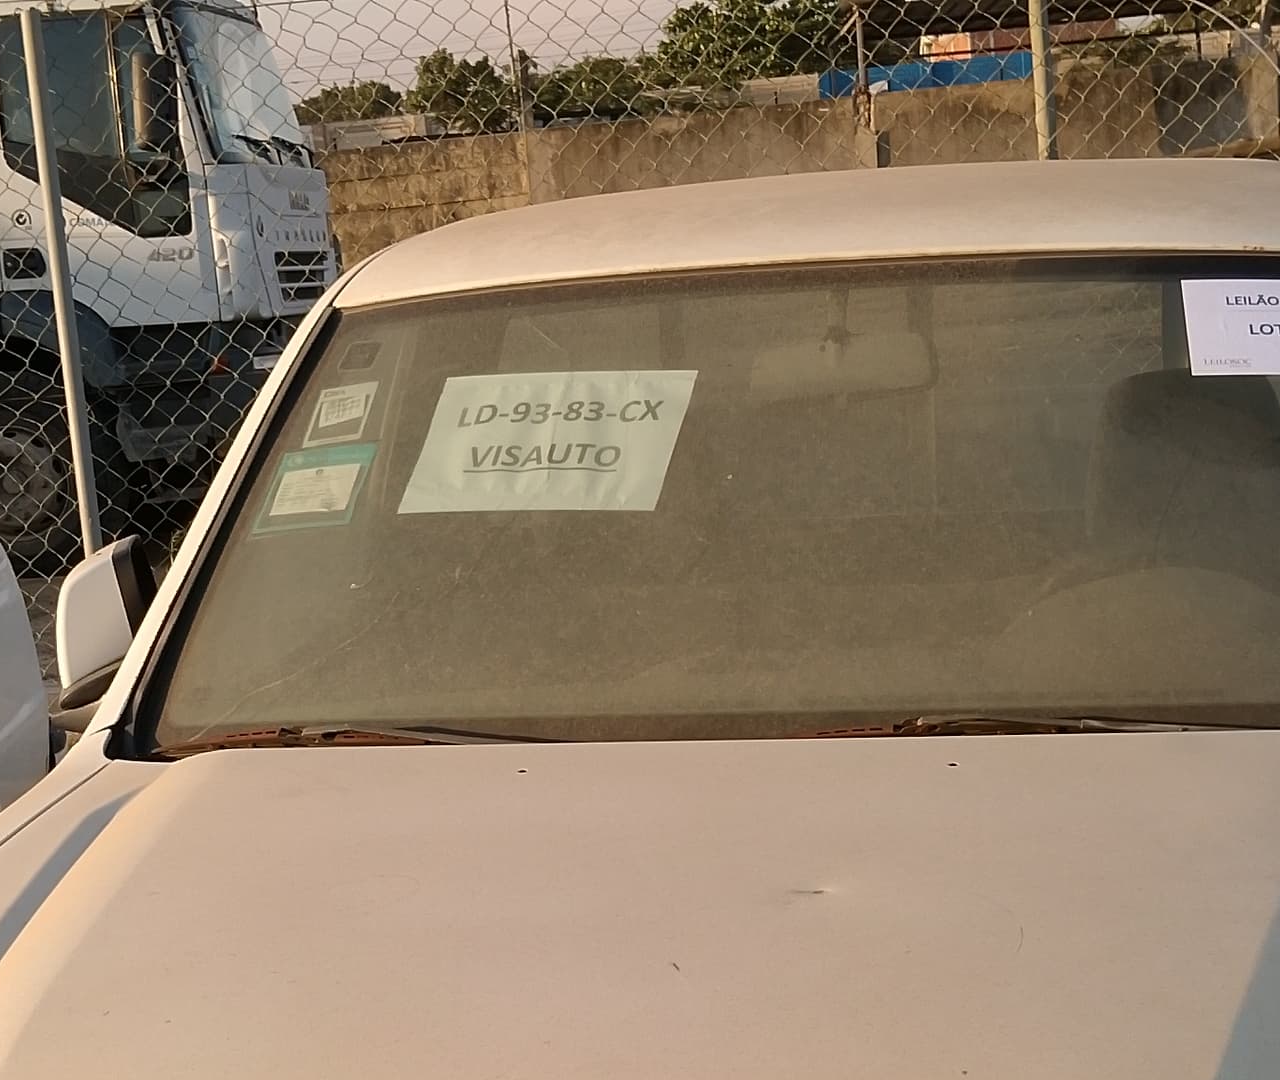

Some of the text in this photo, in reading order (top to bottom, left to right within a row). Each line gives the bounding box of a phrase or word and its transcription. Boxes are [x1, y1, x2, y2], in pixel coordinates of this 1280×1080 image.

[148, 248, 195, 262] 420
[1225, 294, 1280, 306] LEILÃO
[457, 399, 664, 428] LD-93-83-CX
[470, 443, 621, 468] VISAUTO
